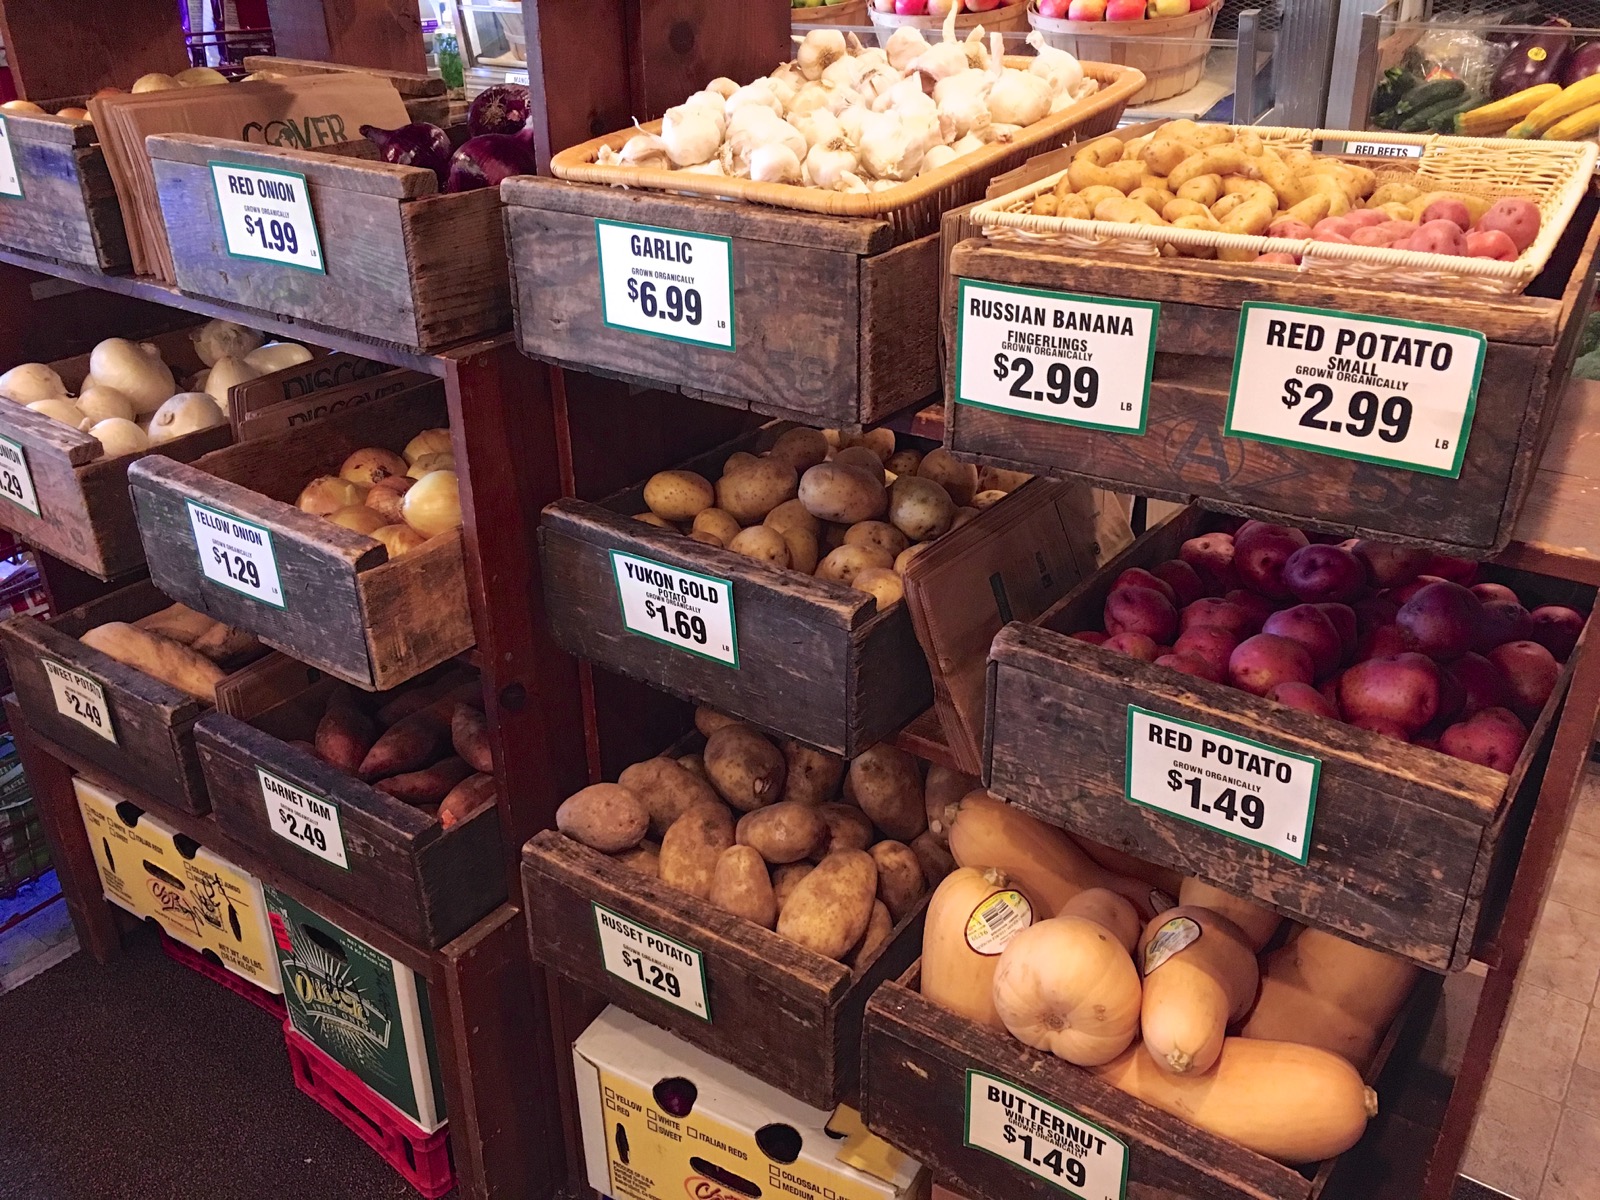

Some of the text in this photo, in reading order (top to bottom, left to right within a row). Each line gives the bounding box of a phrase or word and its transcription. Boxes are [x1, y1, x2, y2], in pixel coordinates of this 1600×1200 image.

[1355, 144, 1409, 157] RED BEETS
[228, 175, 296, 203] RED ONION
[244, 205, 290, 218] GROWN ORGANICALLY
[244, 214, 299, 254] $1.99
[631, 234, 693, 264] GARLIC
[631, 267, 695, 284] GROWN ORGANICALLY
[627, 277, 702, 326] $6.99
[970, 298, 1134, 336] RUSSIAN BANANA
[717, 320, 726, 328] LB
[1002, 341, 1093, 361] GROWN ORGANICALLY
[1007, 330, 1088, 352] FINGERLINGS
[1266, 320, 1454, 371] RED POTATO
[993, 353, 1099, 408] $2.99
[1295, 365, 1409, 391] GROWN ORGANICALLY
[1327, 356, 1379, 377] SMALL
[1120, 402, 1132, 411] LB
[1281, 378, 1413, 443] $2.99
[1435, 438, 1449, 450] LB
[194, 509, 263, 546] YELLOW ONION
[212, 546, 260, 589] $1.29
[624, 561, 718, 603] YUKON GOLD
[646, 592, 701, 614] GROWN ORGANICALLY
[658, 588, 687, 604] POTATO
[645, 600, 707, 645] $1.69
[722, 644, 730, 652] LB
[46, 662, 73, 683] SWEET
[74, 675, 102, 699] POTATO
[64, 690, 102, 728] $2.49
[1148, 723, 1292, 784] RED POTATO
[1173, 760, 1261, 793] GROWN ORGANICALLY
[264, 777, 331, 821] GARNET YAM
[1167, 769, 1265, 830] $1.49
[278, 808, 326, 851] $2.49
[1286, 833, 1297, 843] LB
[600, 912, 693, 967] RUSSET POTATO
[622, 950, 681, 998] $1.29
[616, 1093, 642, 1113] YELLOW
[617, 1104, 630, 1118] RED
[657, 1114, 681, 1131] WHITE
[659, 1126, 683, 1143] SWEET
[987, 1084, 1107, 1156] BUTTERNUT
[1004, 1107, 1088, 1157] WINTER SQUASH
[699, 1132, 748, 1162] ITALIAN REDS
[1008, 1117, 1083, 1159] GROWN ORGANICALLY
[1003, 1124, 1086, 1188] $1.49
[782, 1170, 822, 1195] COLOSSAL
[782, 1182, 815, 1200] MEDIUM
